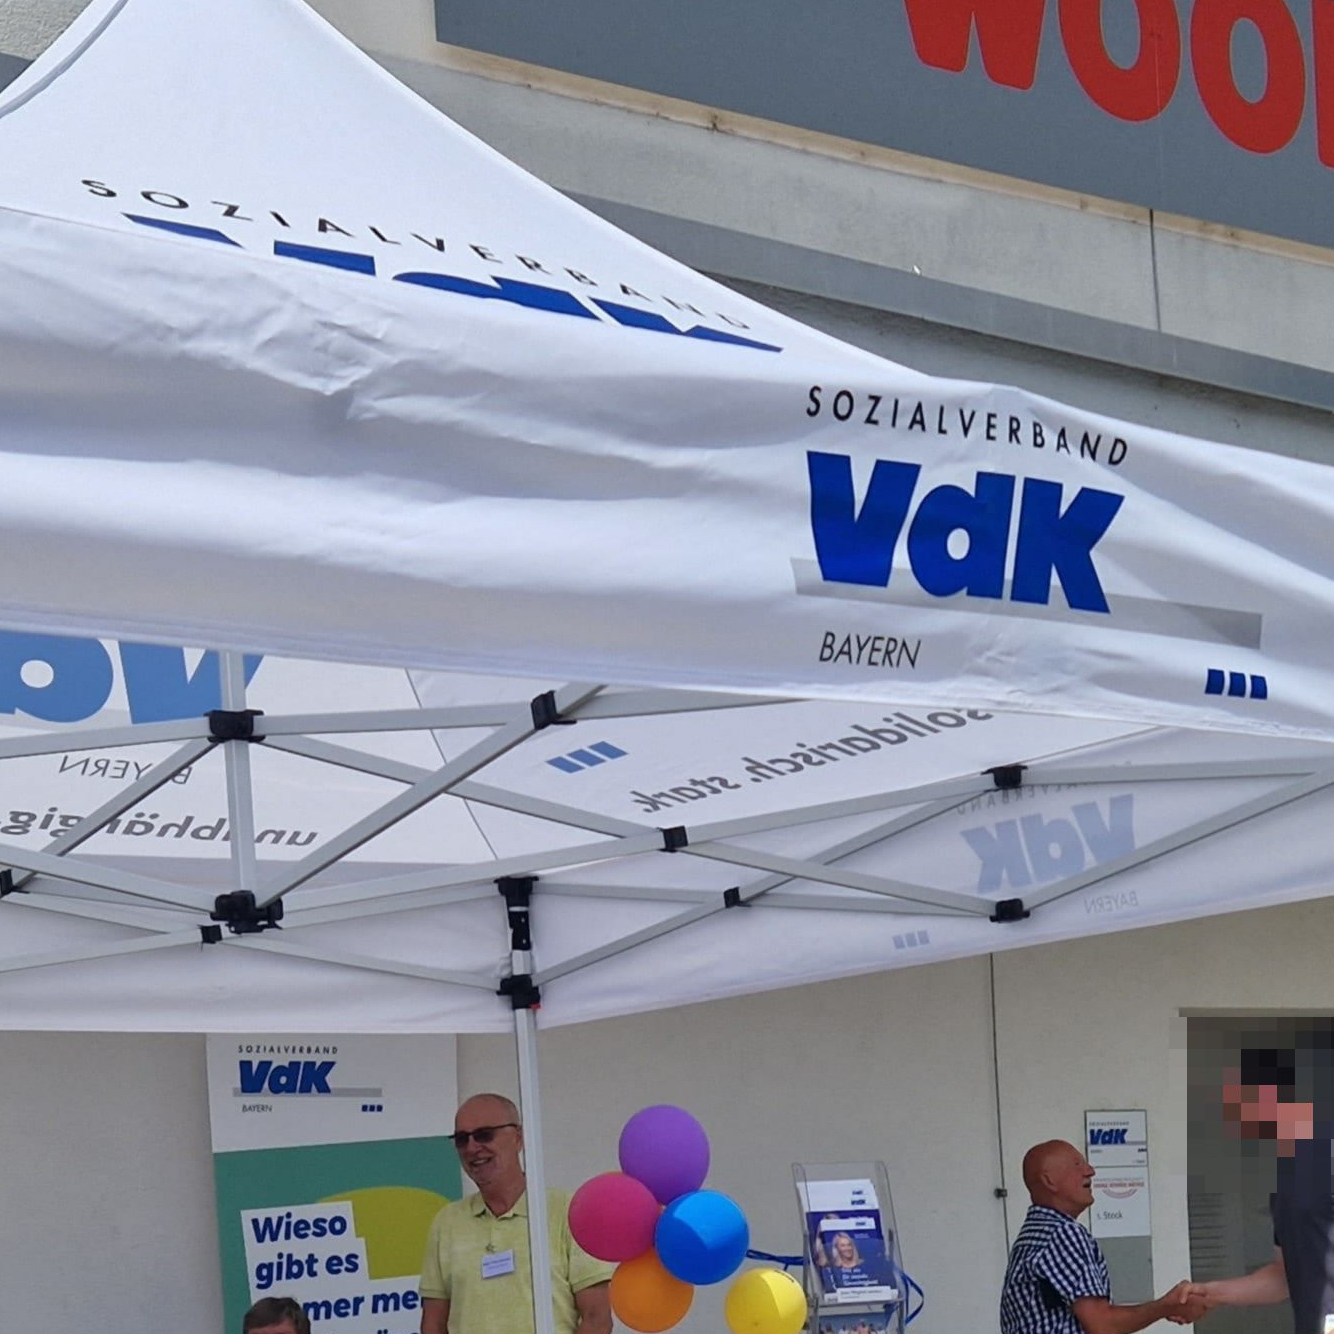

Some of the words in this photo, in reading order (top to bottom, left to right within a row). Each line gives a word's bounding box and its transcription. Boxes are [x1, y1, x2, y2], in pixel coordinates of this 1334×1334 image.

[81, 178, 751, 331] SOZIALVERBAND
[805, 384, 1128, 467] SOZIALVERBAND
[805, 450, 1126, 615] VdK
[818, 631, 922, 671] BAYERN
[237, 1044, 339, 1055] SOZIALVERBAND
[238, 1059, 337, 1095] VdK
[241, 1104, 273, 1113] BAYERN
[1089, 1128, 1128, 1145] VdK
[250, 1211, 348, 1244] Wieso
[255, 1251, 319, 1290] gibt
[325, 1252, 360, 1275] es
[303, 1296, 365, 1321] mer
